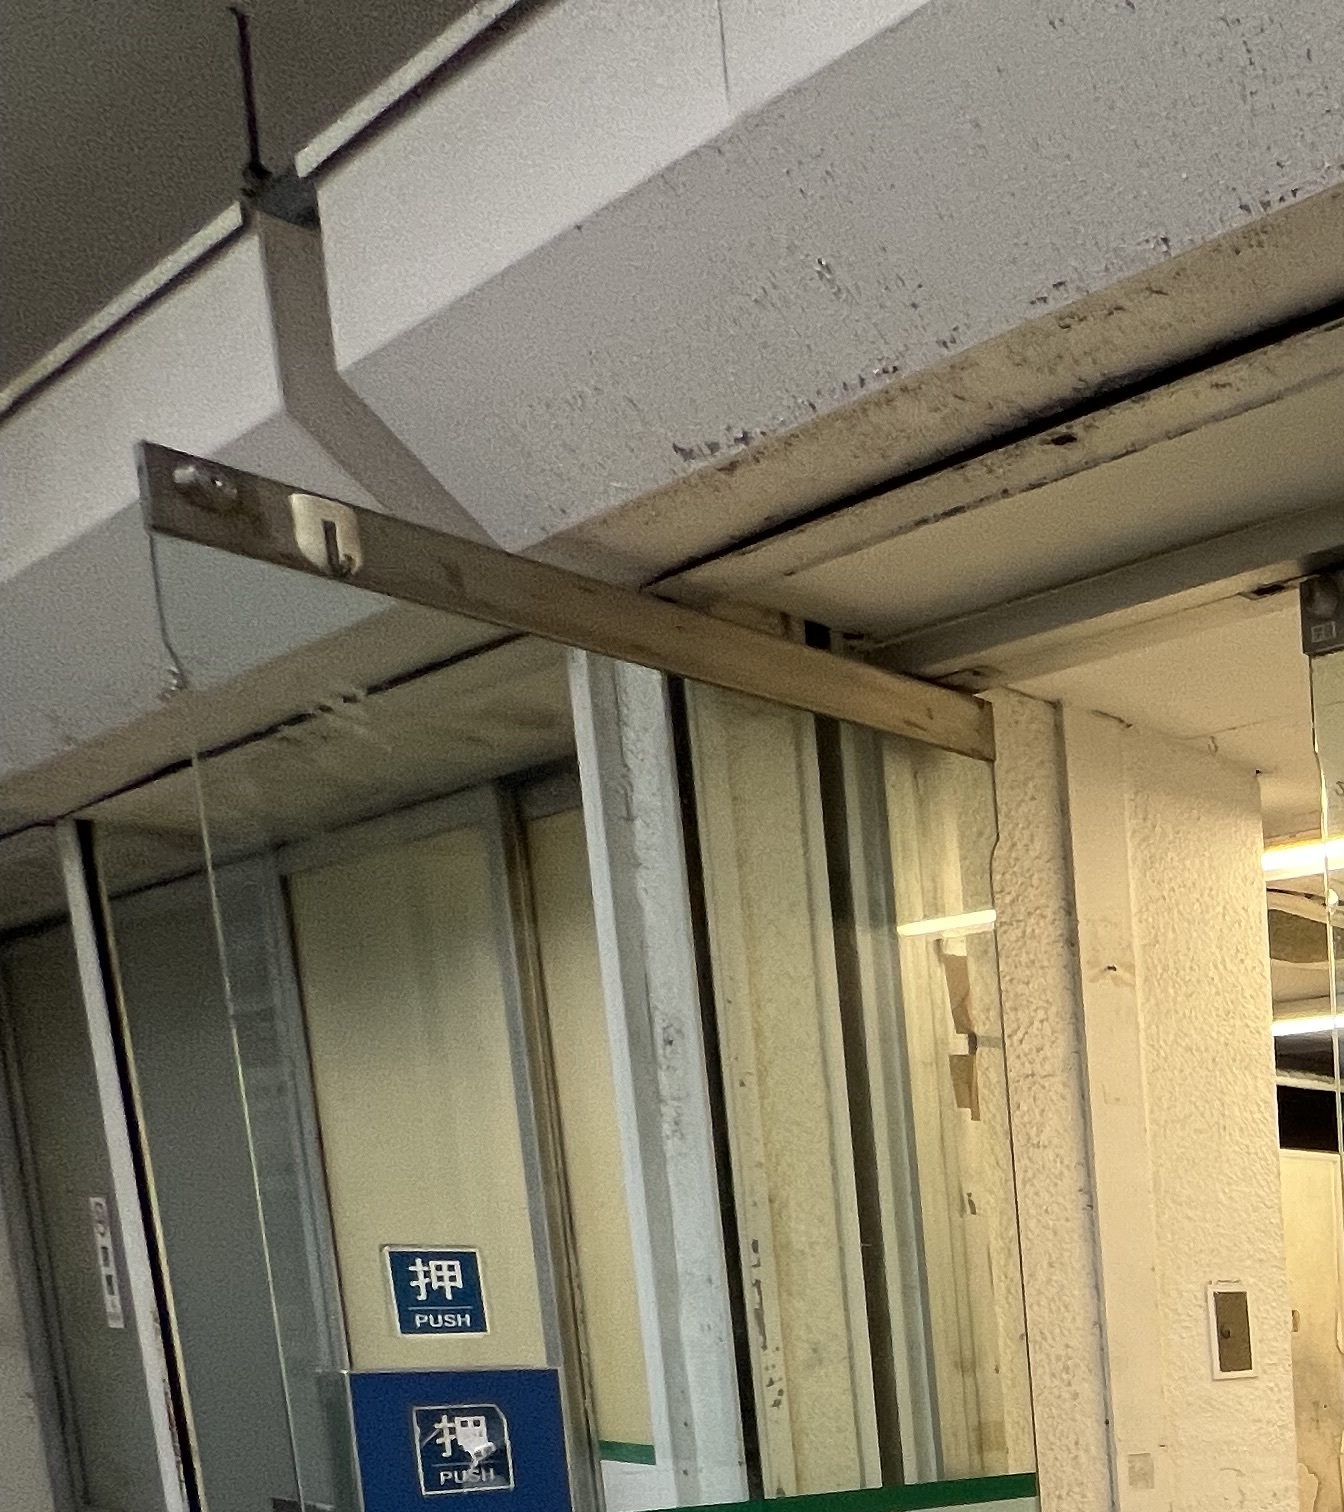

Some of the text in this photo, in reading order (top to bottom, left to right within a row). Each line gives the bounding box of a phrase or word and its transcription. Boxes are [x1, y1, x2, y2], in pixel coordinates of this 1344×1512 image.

[408, 1257, 464, 1301] 押
[414, 1312, 471, 1329] PUSH
[439, 1466, 495, 1485] PUSH
